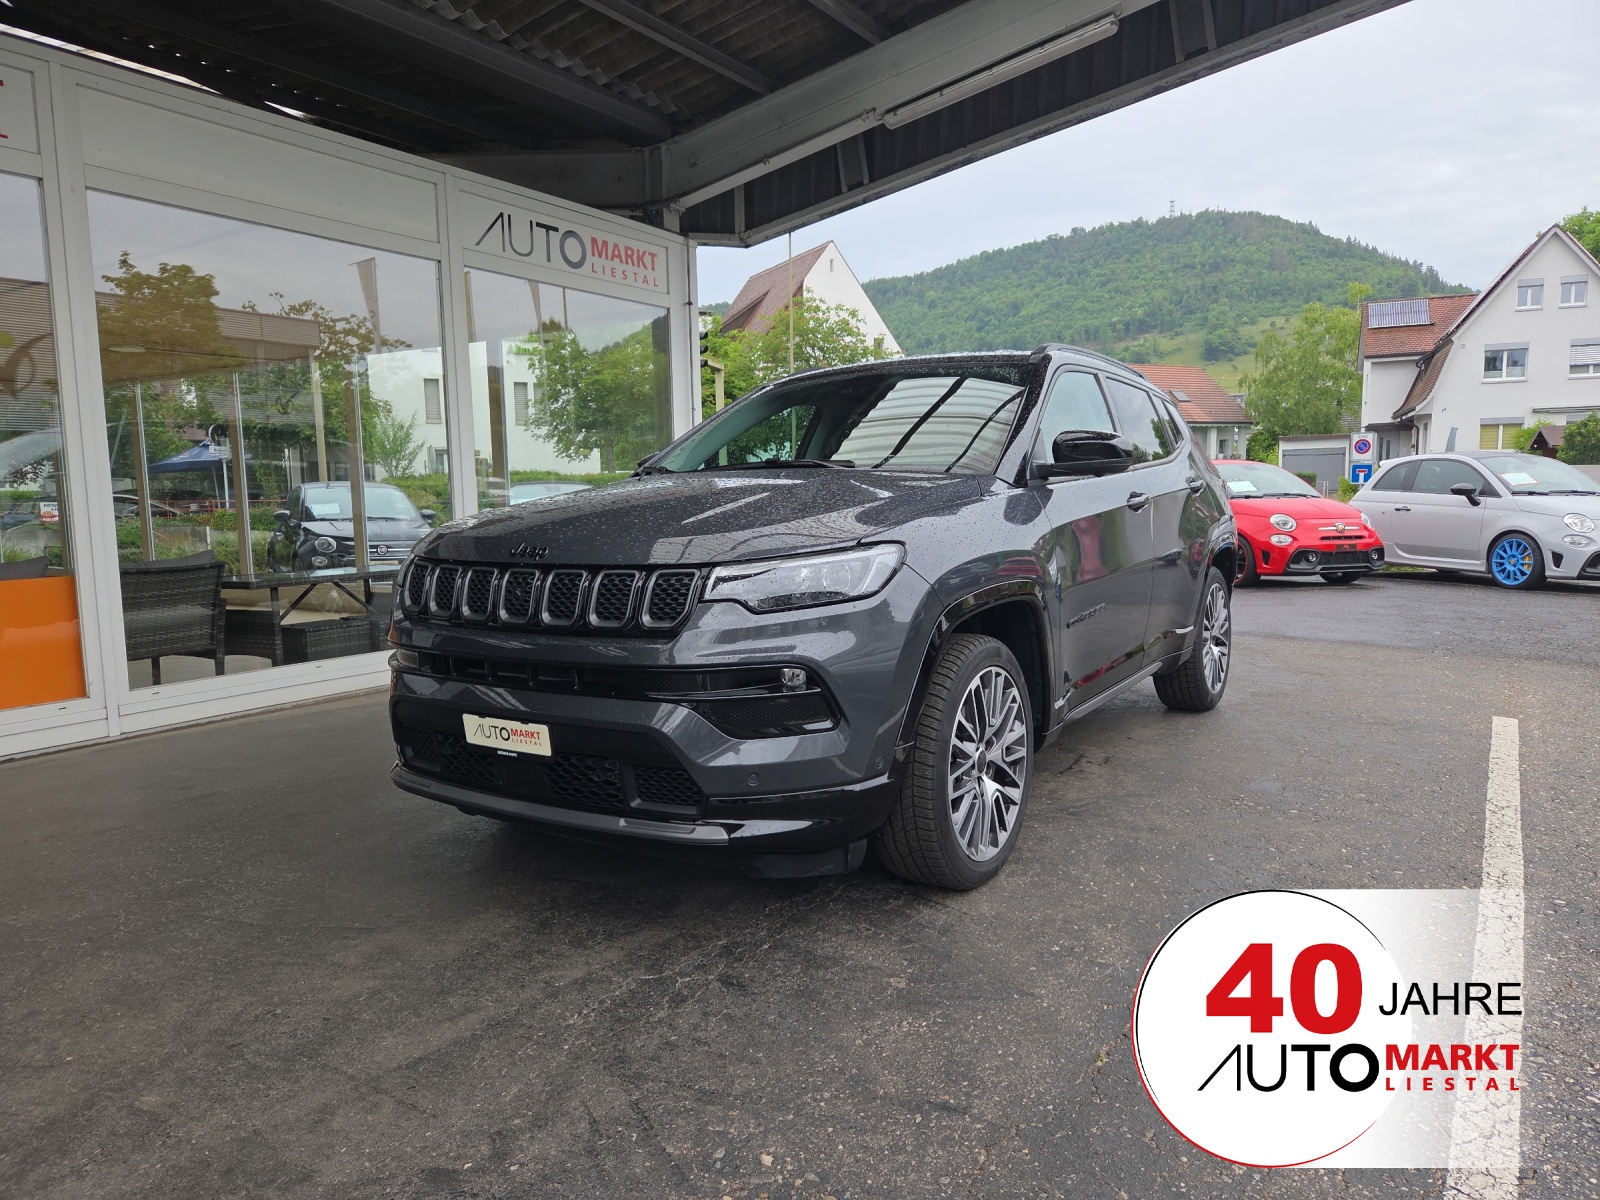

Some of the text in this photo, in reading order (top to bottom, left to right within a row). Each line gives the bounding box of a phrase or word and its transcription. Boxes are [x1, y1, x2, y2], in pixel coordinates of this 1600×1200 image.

[475, 212, 658, 272] AUTO MARKT
[591, 262, 659, 287] LIESTAL
[510, 543, 549, 561] Jeep
[474, 724, 541, 741] AUTO MARKT
